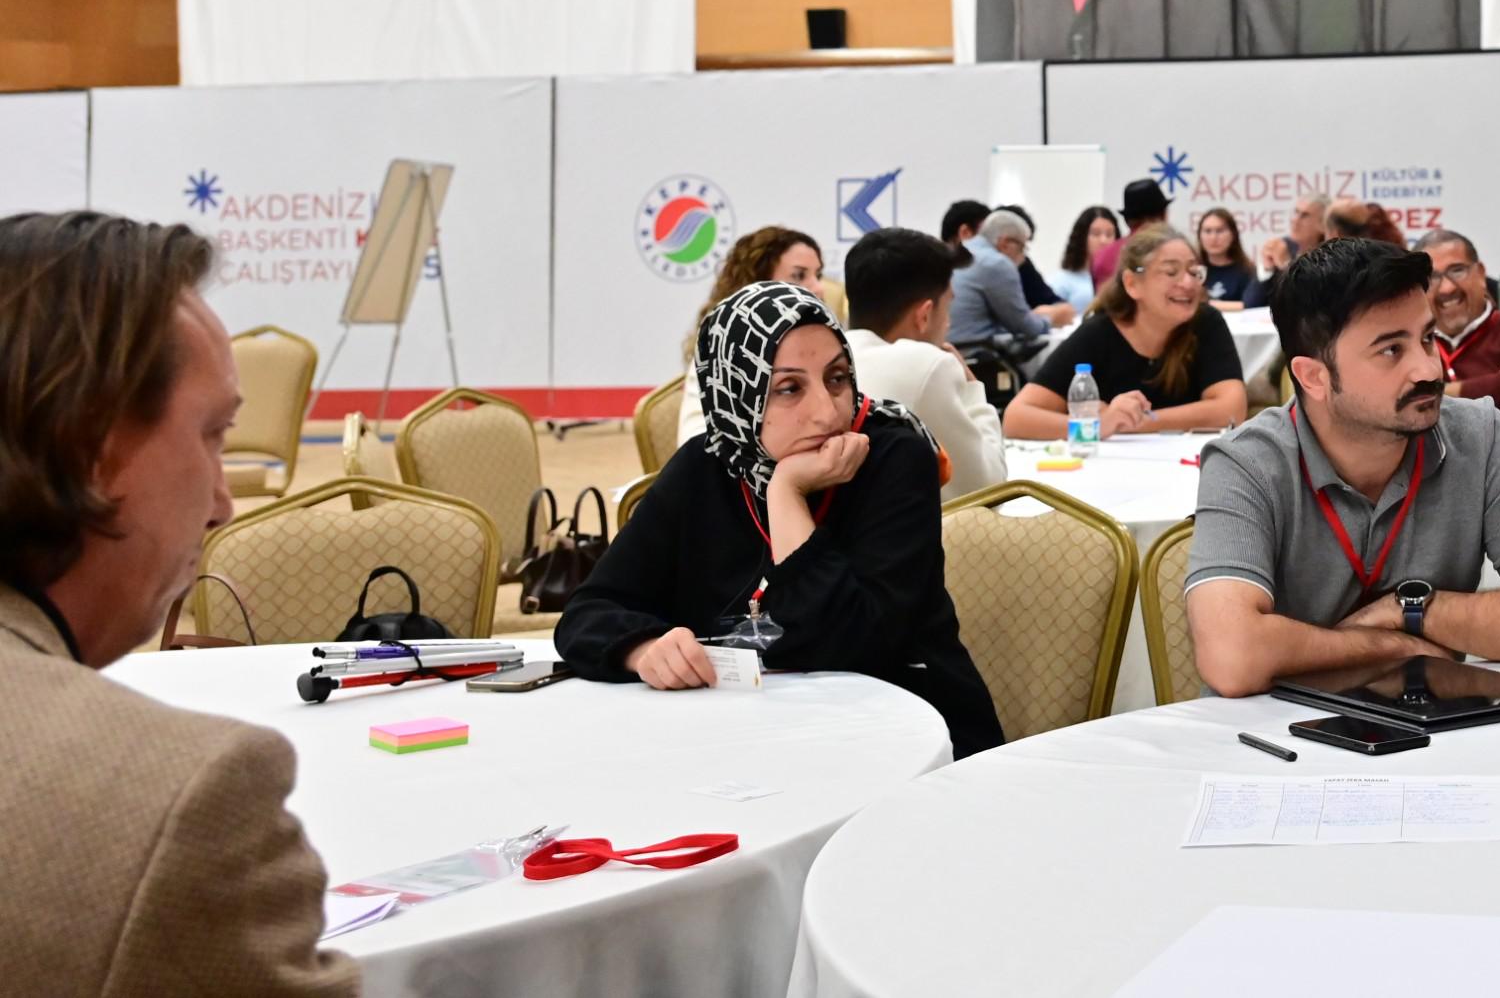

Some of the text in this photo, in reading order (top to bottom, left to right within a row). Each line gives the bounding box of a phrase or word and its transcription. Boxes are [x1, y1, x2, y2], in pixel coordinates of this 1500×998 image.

[1190, 165, 1356, 202] AKDENİZ
[1371, 167, 1429, 182] KÜLTÜR
[219, 186, 365, 222] AKDENİZ
[218, 225, 347, 253] BAŞKENTİ
